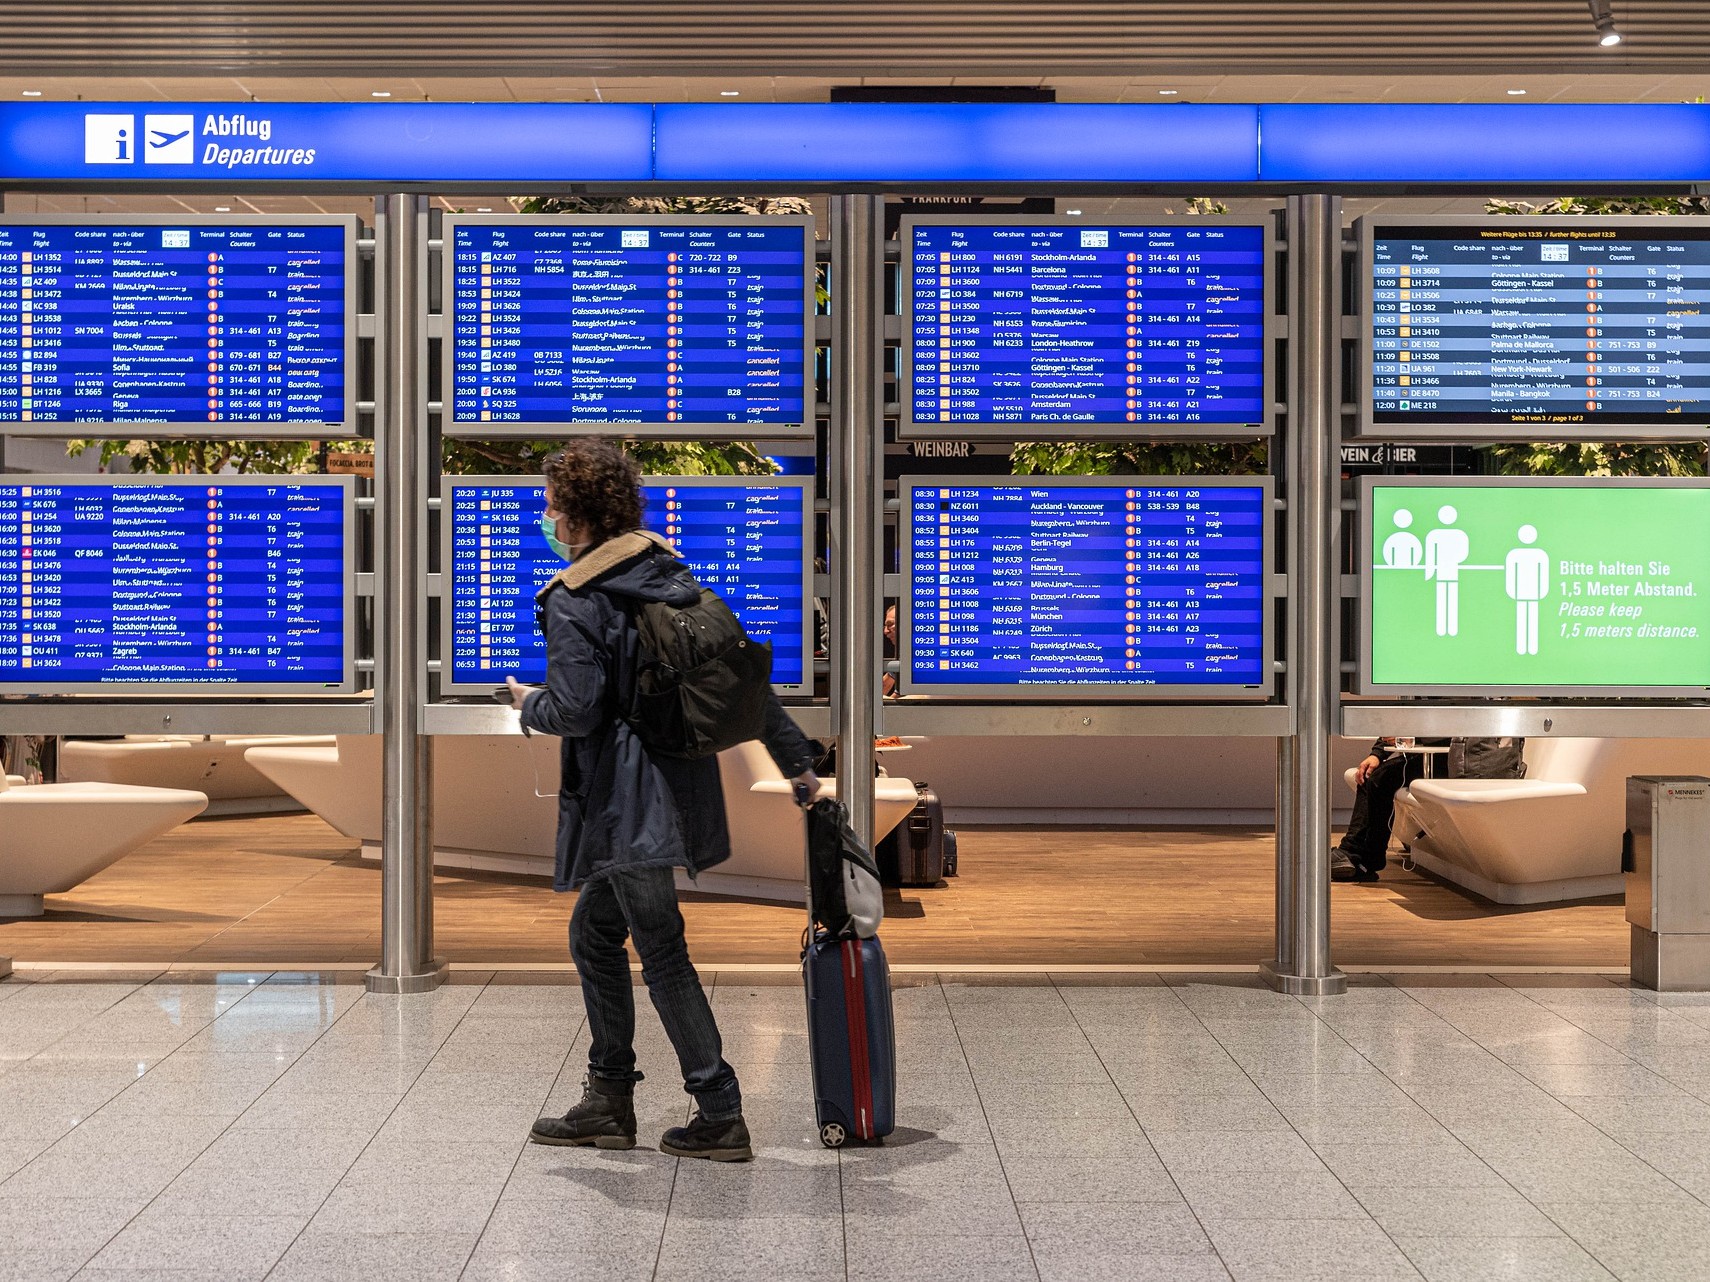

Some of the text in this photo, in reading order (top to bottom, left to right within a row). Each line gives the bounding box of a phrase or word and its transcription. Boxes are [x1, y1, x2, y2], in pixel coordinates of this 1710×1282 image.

[203, 115, 271, 141] Abflug
[203, 143, 316, 168] Departures
[1491, 280, 1526, 288] Göttingen
[1520, 390, 1550, 398] Bangkok
[113, 400, 128, 409] Riga
[914, 442, 969, 457] WEINBAR
[491, 490, 500, 498] JU
[1031, 539, 1072, 548] Berlin-Tegel
[74, 550, 85, 558] QF
[1031, 564, 1064, 573] Hamburg
[1560, 560, 1670, 576] Bitte halten Sie
[1560, 581, 1697, 597] 1,5 Meter Abstand.
[1558, 602, 1643, 620] Please keep
[1560, 623, 1699, 639] 1,5 meters distance.
[113, 648, 137, 657] Zagreb
